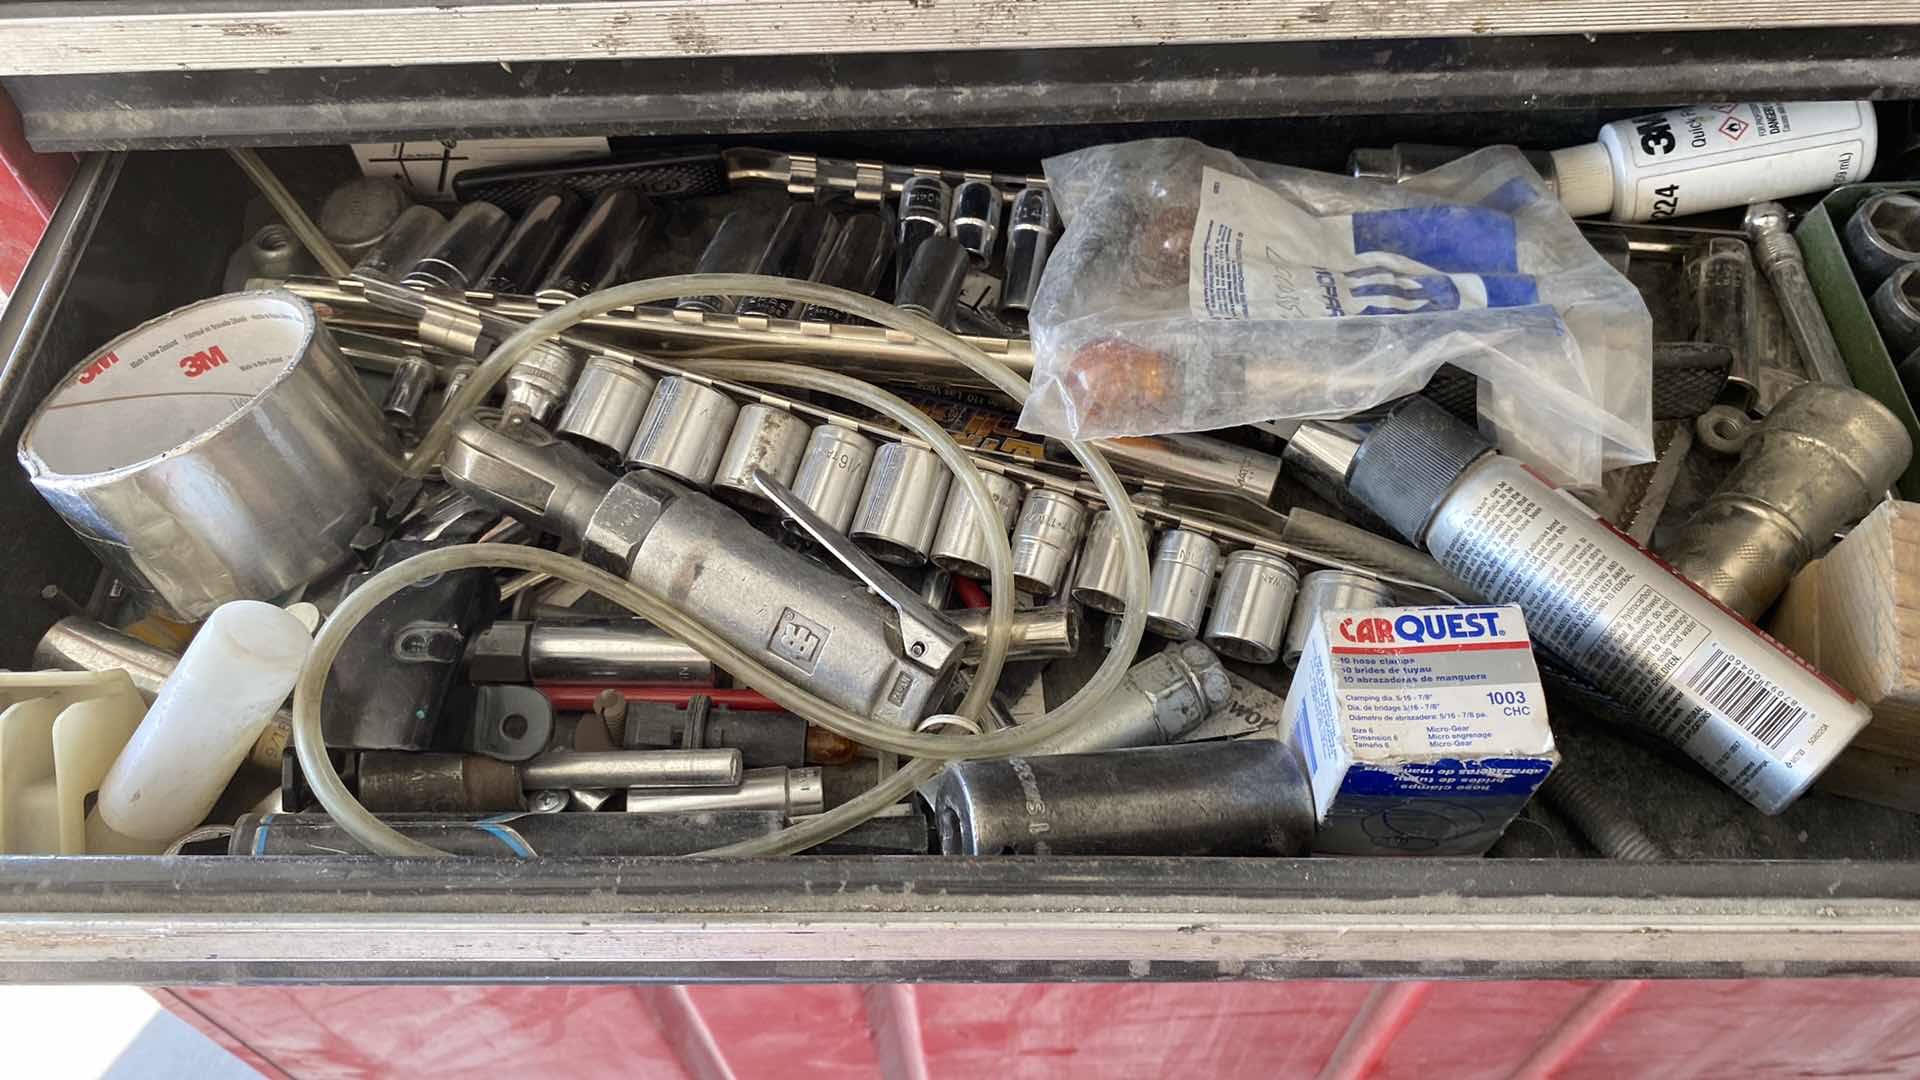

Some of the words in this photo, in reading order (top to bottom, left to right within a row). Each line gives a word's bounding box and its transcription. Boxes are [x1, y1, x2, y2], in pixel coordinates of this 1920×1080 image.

[1632, 114, 1676, 156] 3M
[179, 345, 229, 378] 3M
[1486, 690, 1526, 705] 1003
[1503, 705, 1531, 717] CHC
[1426, 724, 1470, 733] Micro-Gear
[1429, 739, 1473, 748] Micro-Gear
